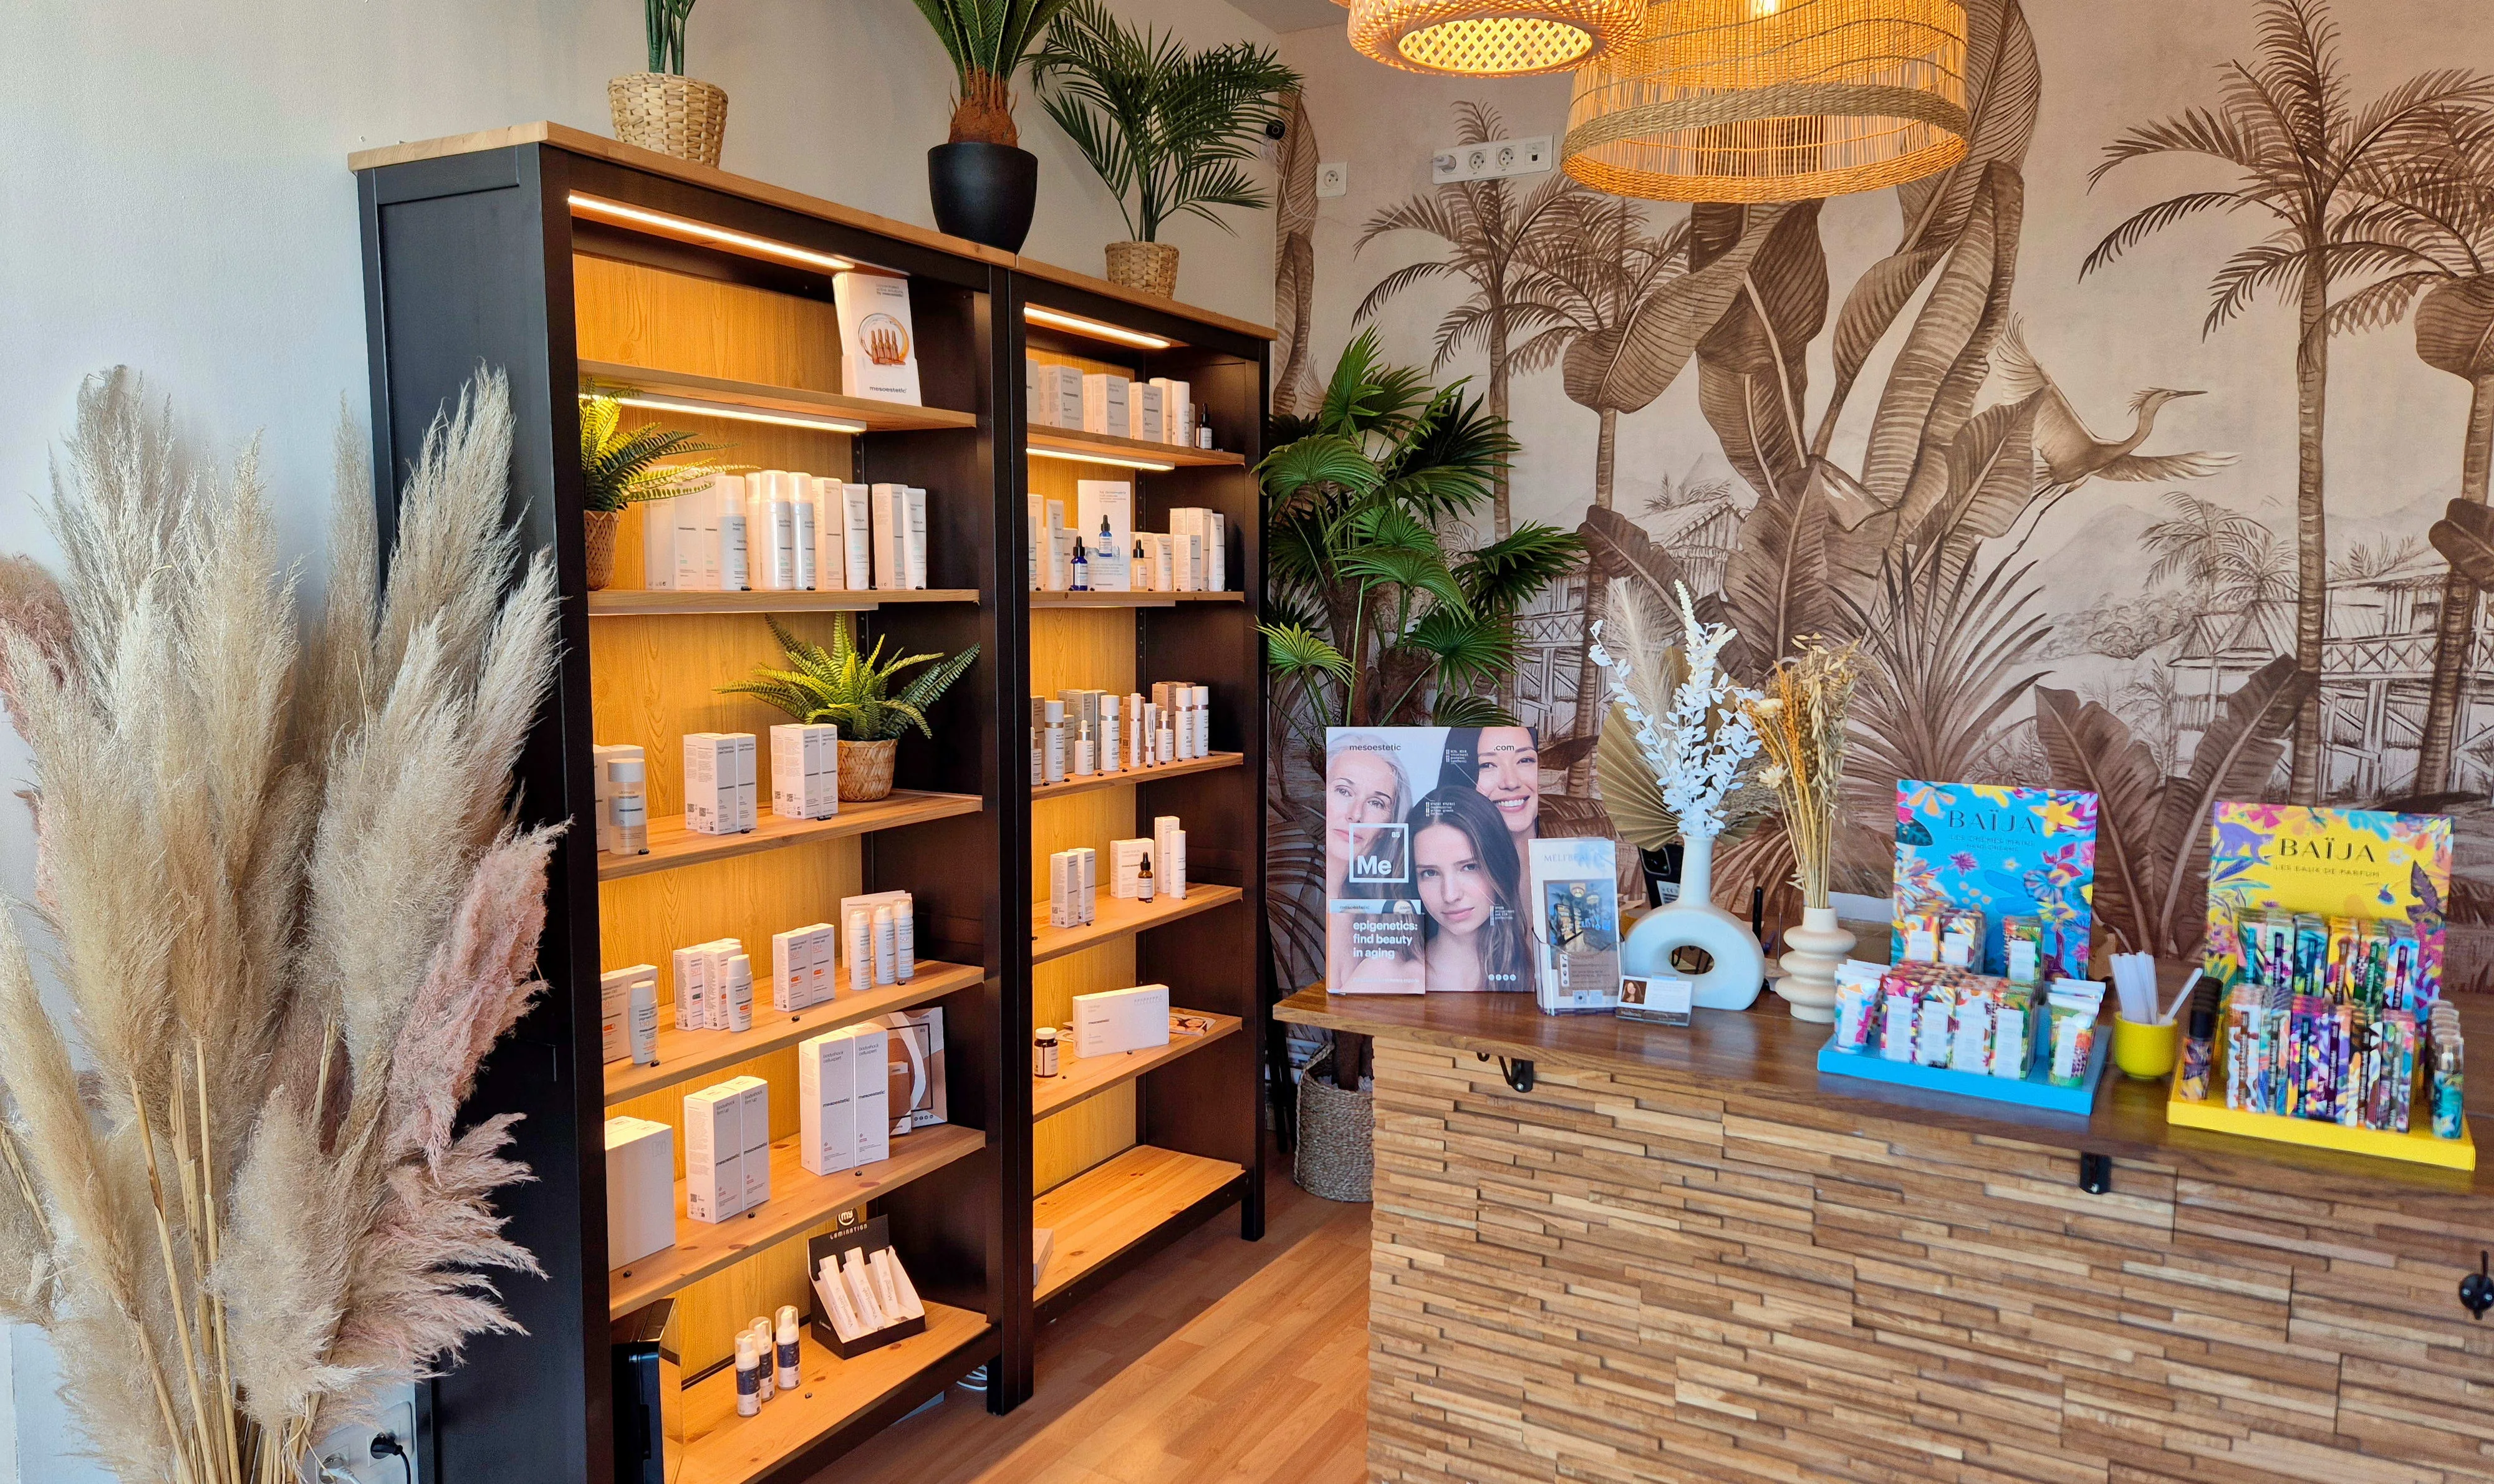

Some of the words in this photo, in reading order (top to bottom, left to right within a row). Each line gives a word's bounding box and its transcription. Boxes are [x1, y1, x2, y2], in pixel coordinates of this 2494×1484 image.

[1950, 809, 2036, 834] BAÏJA
[2280, 837, 2375, 863] BAÏJA
[1357, 855, 1392, 875] Me
[2340, 869, 2380, 877] PARFUM
[1352, 920, 1418, 933] epigenetics:
[1352, 933, 1374, 945] find
[1376, 934, 1413, 946] beauty
[1352, 947, 1363, 958] in
[1365, 947, 1395, 960] aging
[840, 1210, 854, 1220] my
[830, 1223, 868, 1240] LAMINATION
